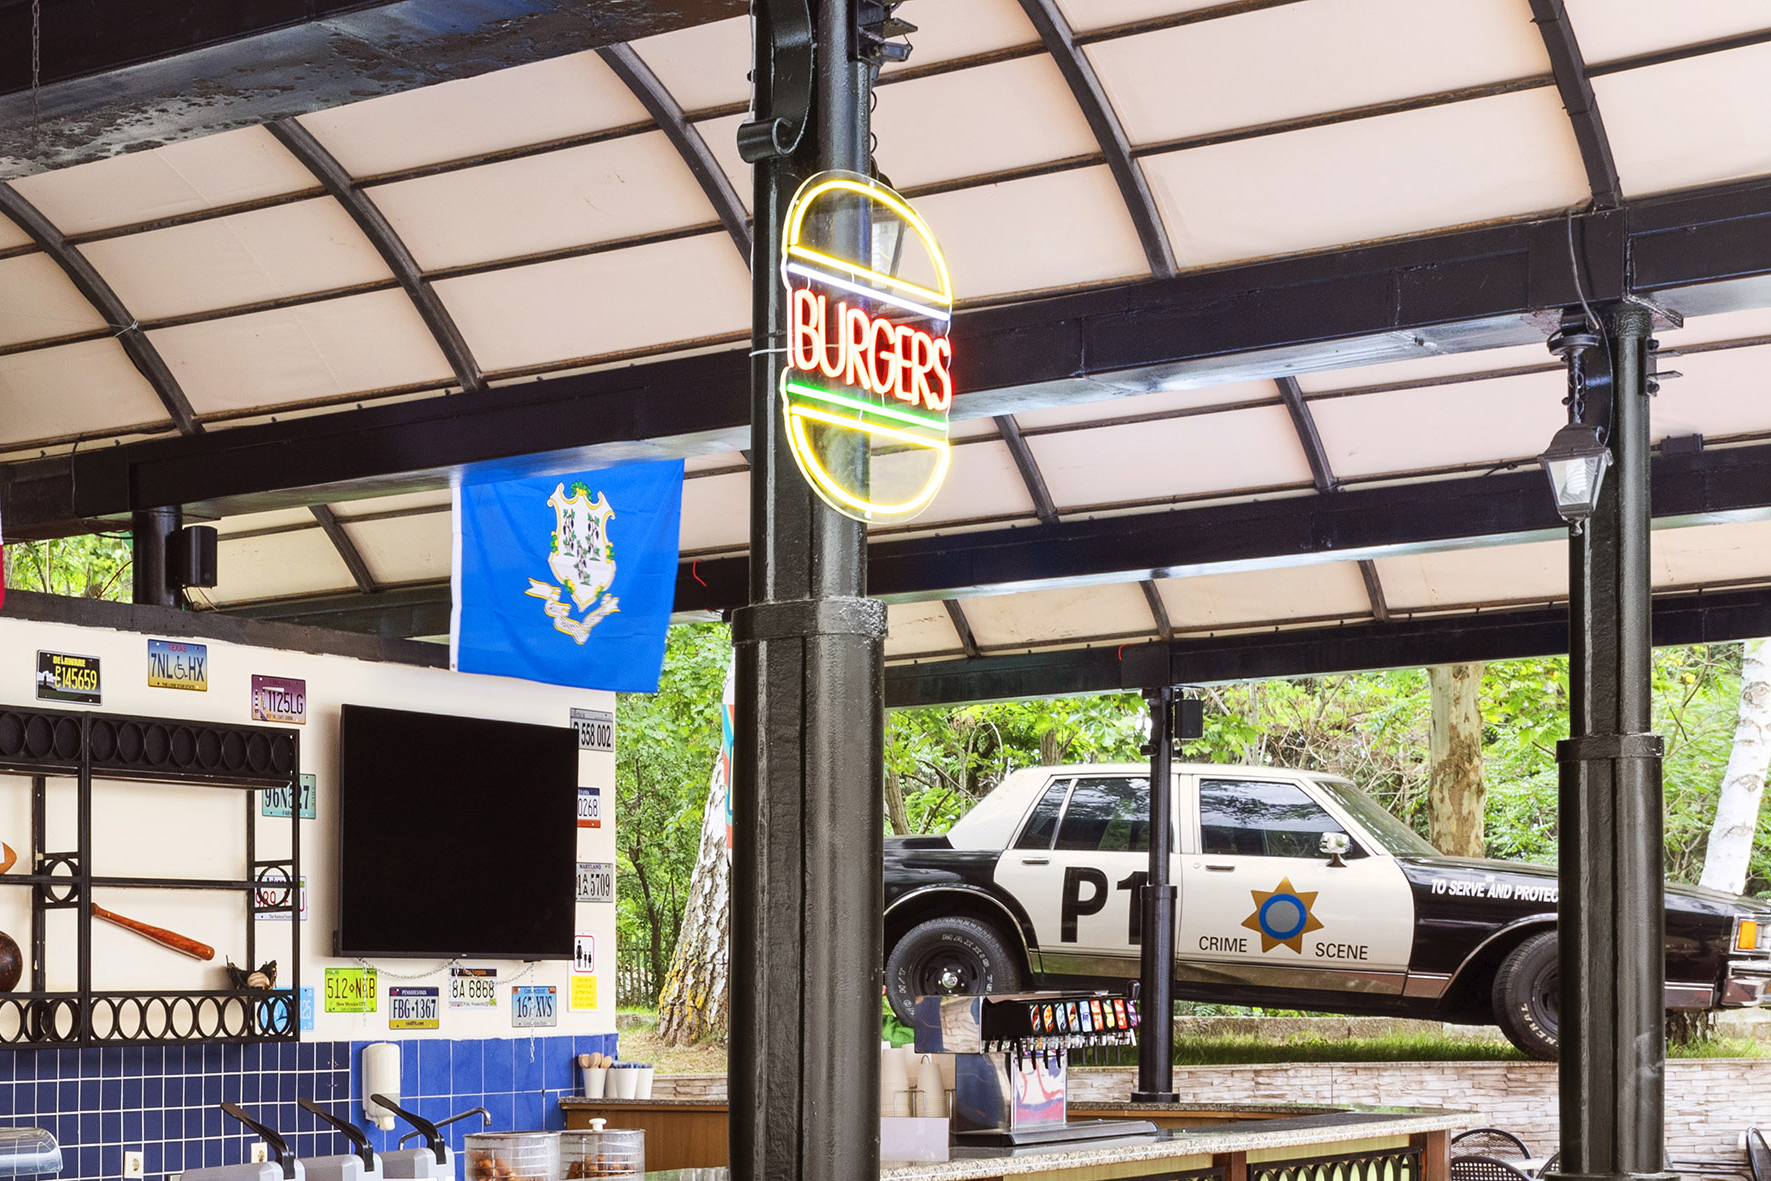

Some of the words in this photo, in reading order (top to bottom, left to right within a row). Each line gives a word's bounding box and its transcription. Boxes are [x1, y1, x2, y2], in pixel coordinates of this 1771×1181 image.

[794, 288, 952, 411] BURGERS
[168, 643, 187, 653] TEXAS
[62, 667, 97, 691] 145659
[151, 652, 173, 679] 7NL
[188, 656, 204, 682] HX
[581, 722, 595, 746] 558
[1431, 879, 1447, 894] TO
[1448, 880, 1486, 897] SERVE
[1487, 882, 1512, 899] AND
[1061, 866, 1149, 945] P1
[1198, 936, 1247, 953] CRIME
[1314, 942, 1369, 961] SCENE
